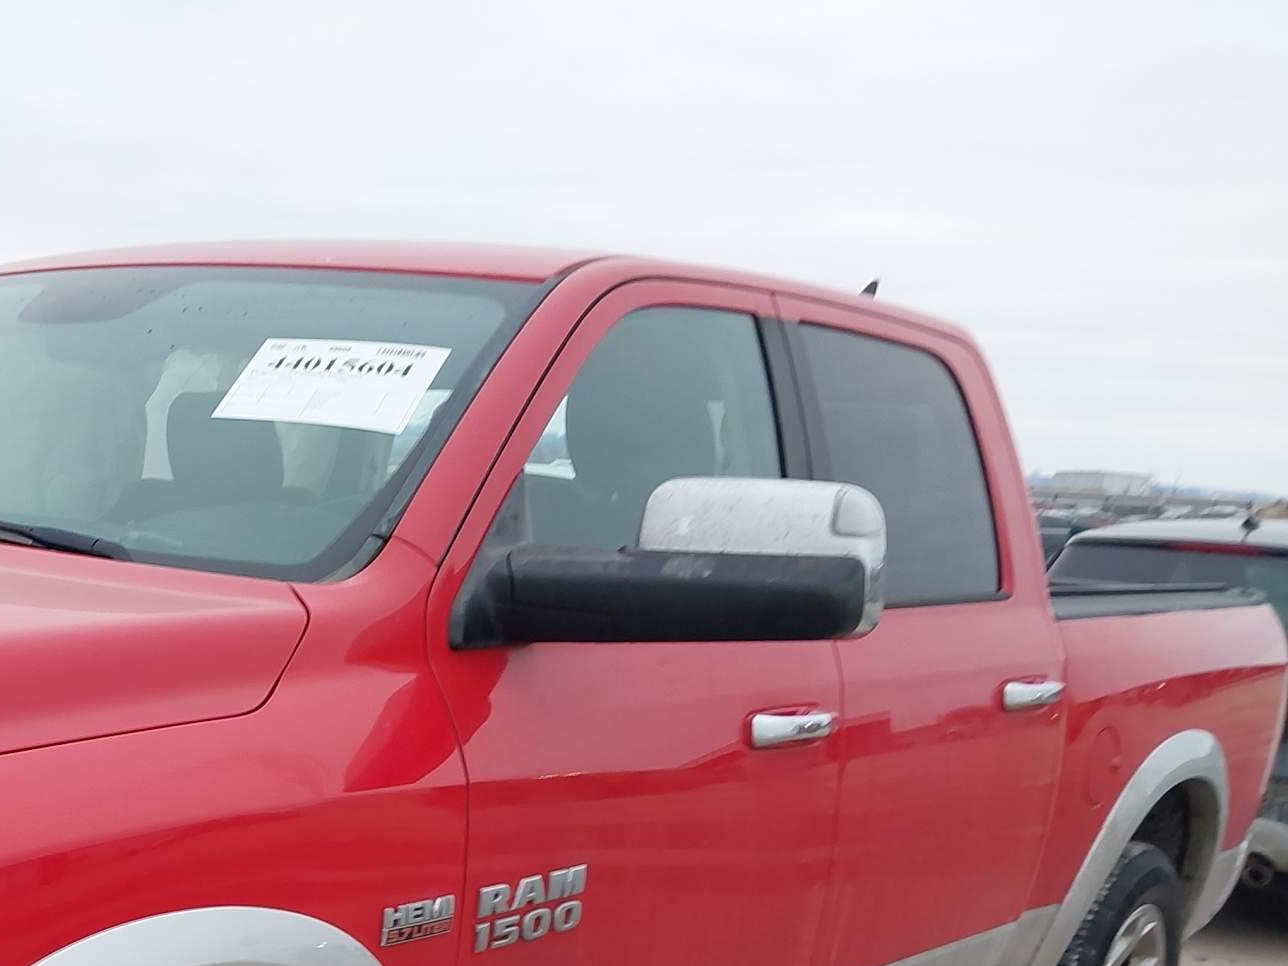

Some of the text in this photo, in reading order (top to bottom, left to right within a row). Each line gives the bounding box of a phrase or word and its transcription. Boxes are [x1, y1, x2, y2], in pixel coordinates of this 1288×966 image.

[267, 355, 414, 377] 44015604
[383, 894, 456, 929] HEMI
[478, 864, 588, 918] RAM
[475, 901, 583, 953] 1500
